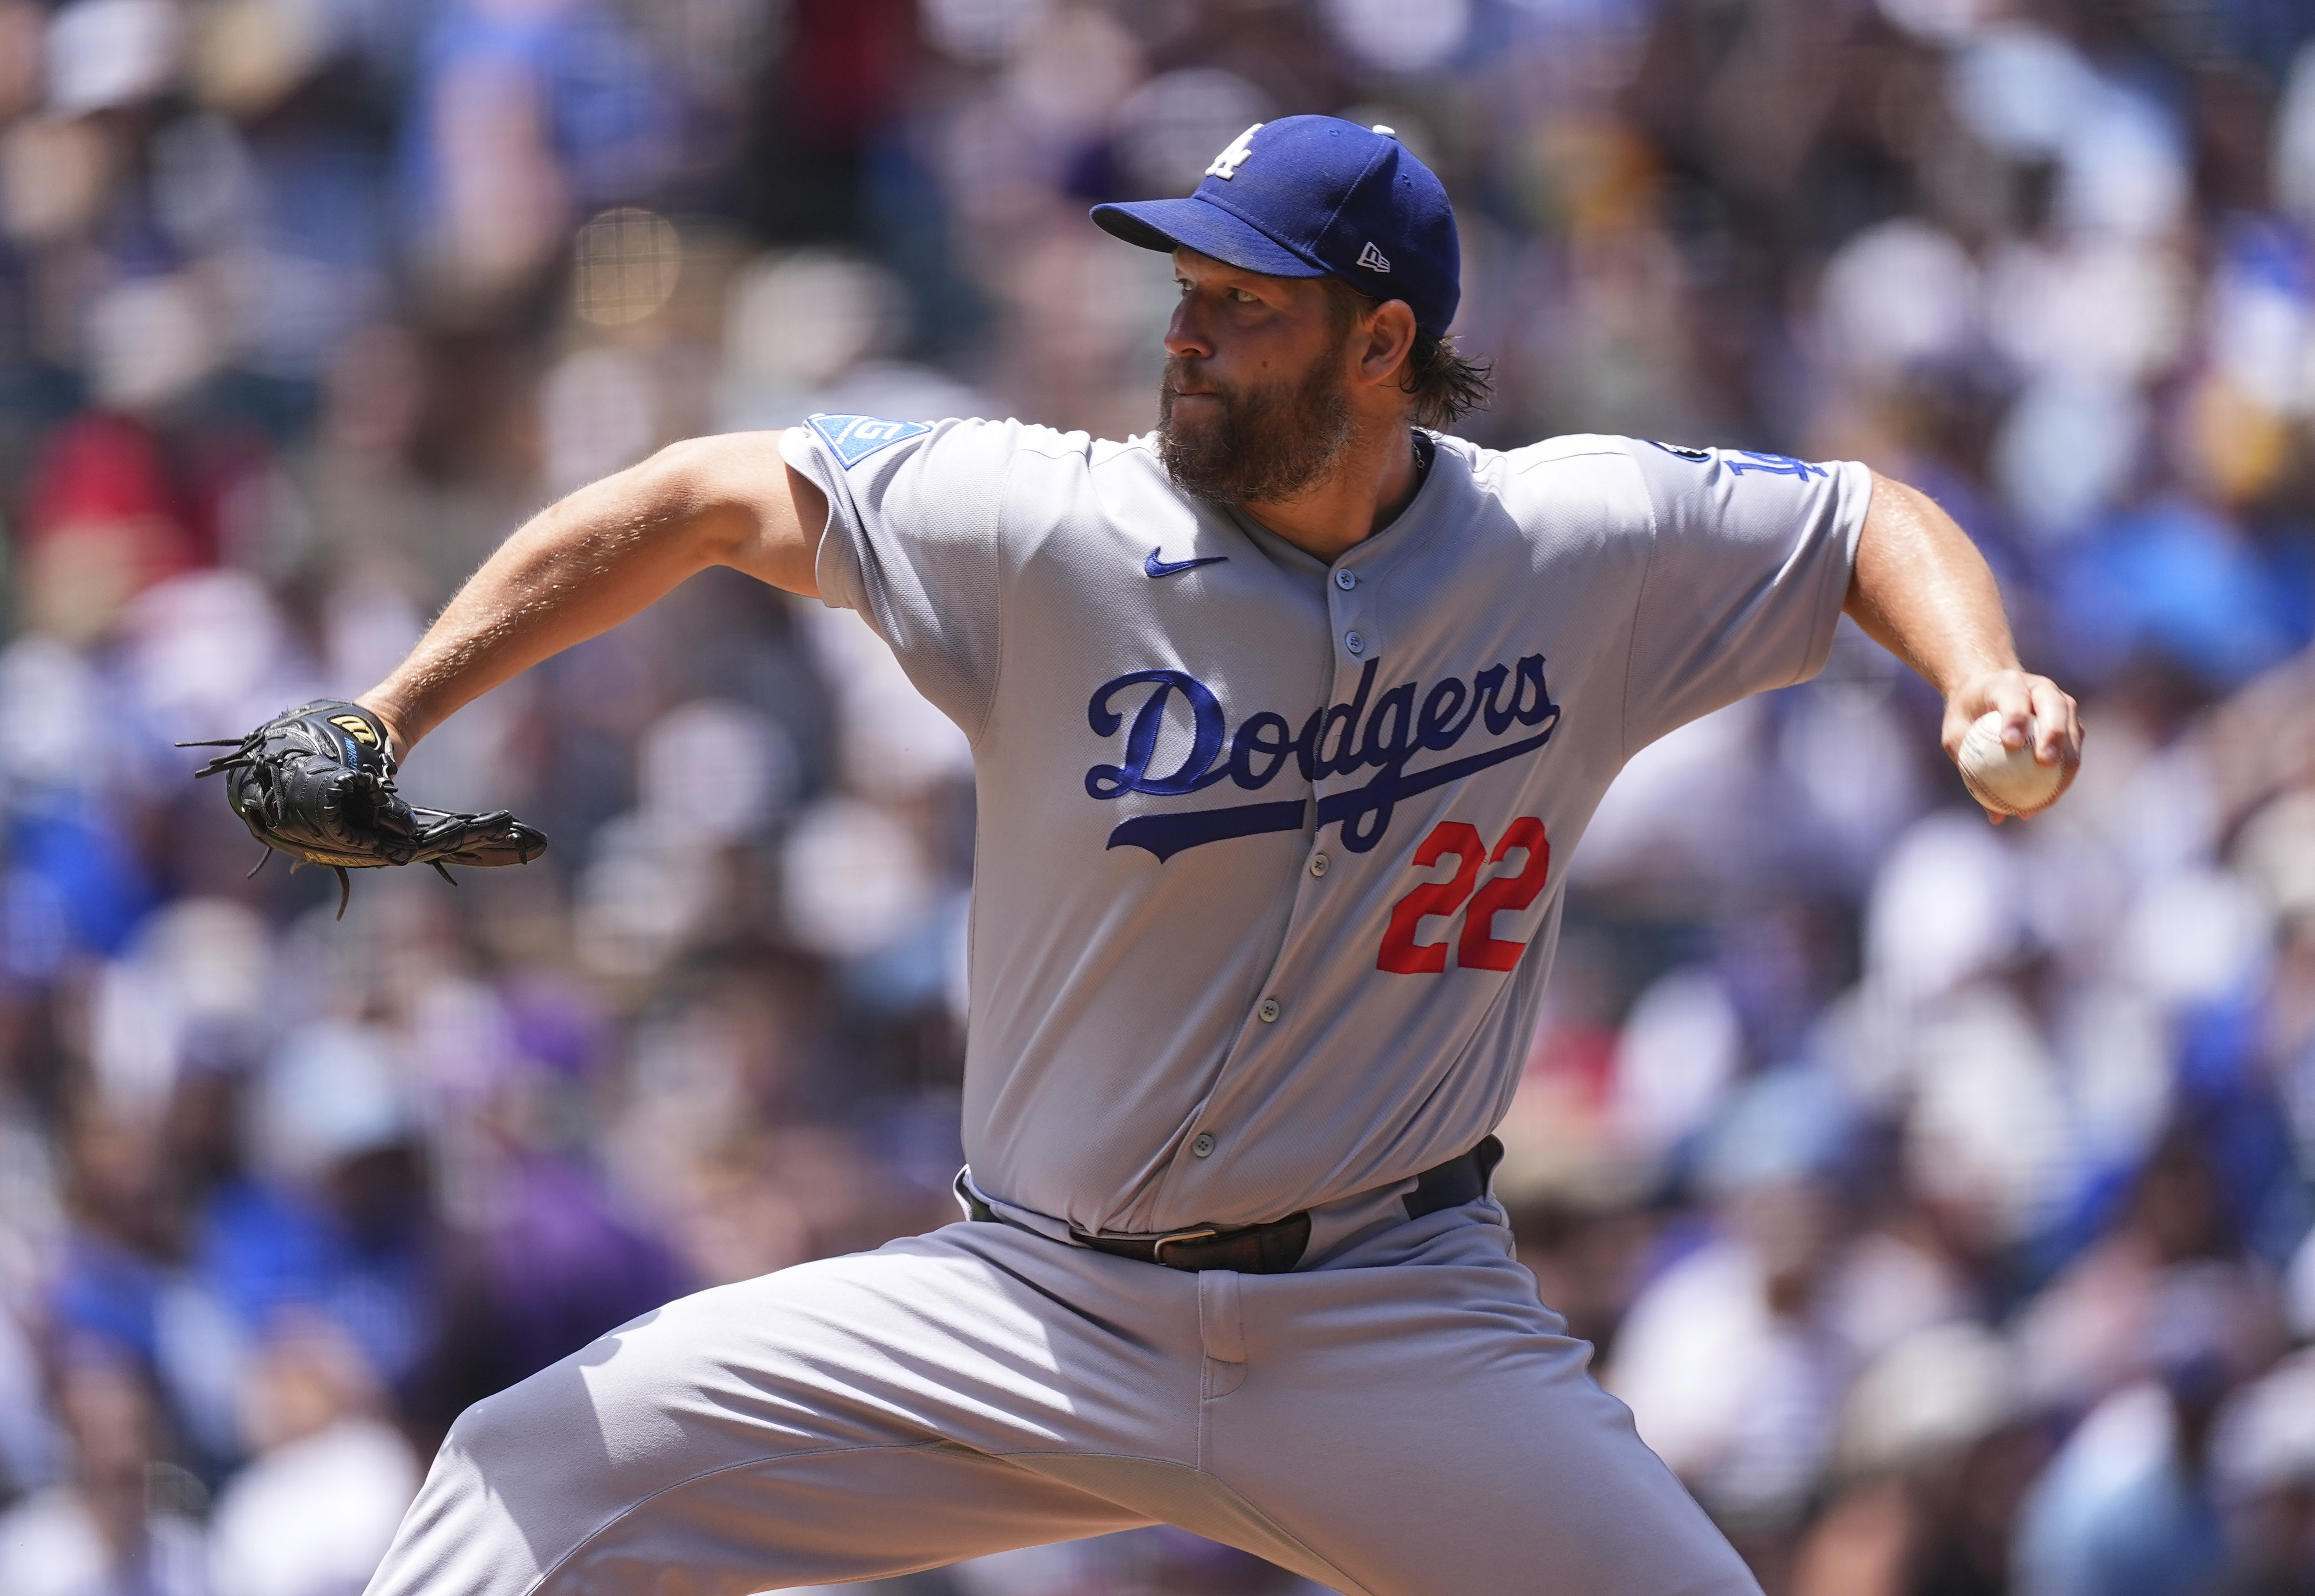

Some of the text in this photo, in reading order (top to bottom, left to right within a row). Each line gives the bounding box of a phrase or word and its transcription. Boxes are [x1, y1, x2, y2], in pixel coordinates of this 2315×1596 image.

[344, 736, 357, 769] RSHAW
[1085, 654, 1559, 853] Dodgers
[1376, 816, 1551, 974] 22
